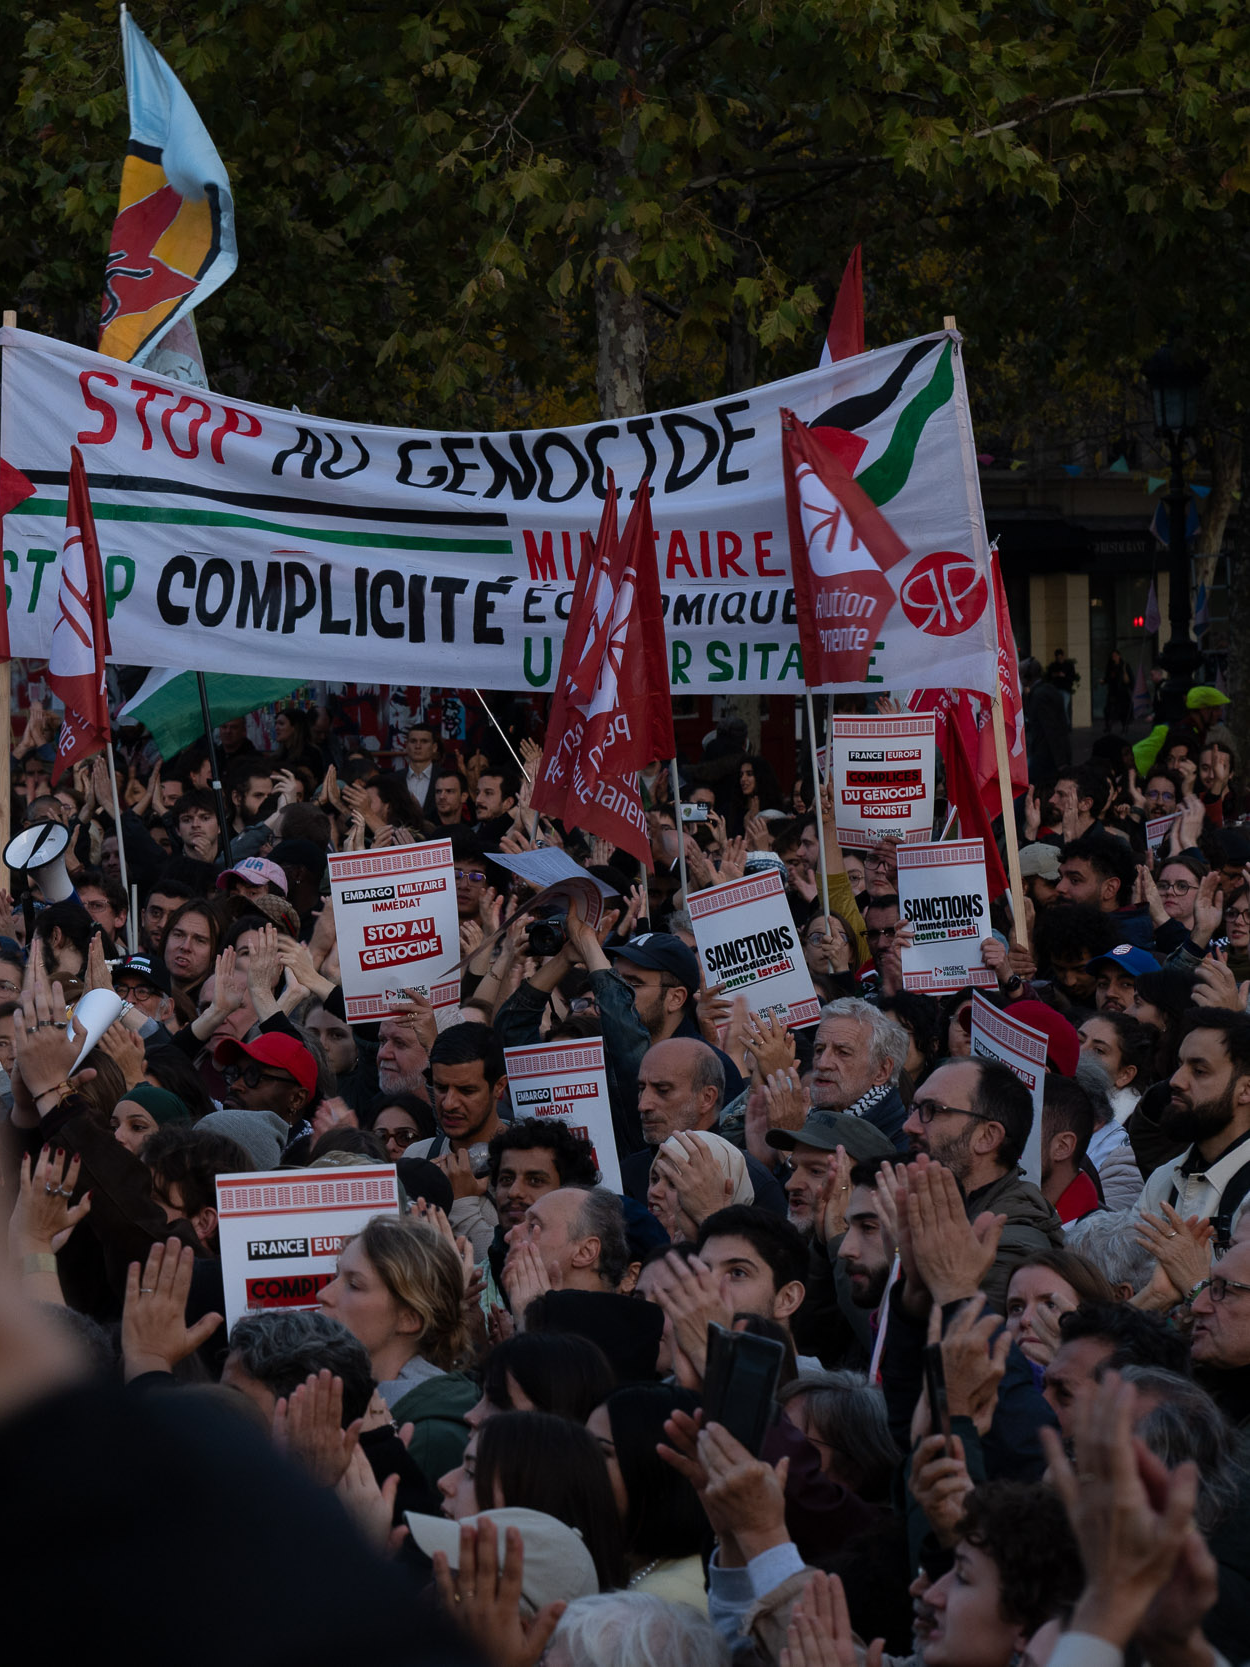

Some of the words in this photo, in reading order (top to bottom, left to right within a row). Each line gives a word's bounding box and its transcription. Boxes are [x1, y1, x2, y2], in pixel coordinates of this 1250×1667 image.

[77, 370, 262, 464] STOP
[271, 426, 370, 481] AU
[396, 400, 756, 503] GENOCIDE
[523, 530, 786, 581] MIAIRE
[2, 549, 136, 619] STP
[157, 555, 519, 645] COMPLICITÉ
[887, 750, 919, 759] EUROPE
[850, 771, 918, 783] COMPLICES
[844, 791, 860, 801] DU
[862, 785, 923, 801] GÉNOCIDE
[863, 805, 909, 815] SIONISTE
[344, 887, 393, 901] EMBARGO
[399, 880, 444, 894] MILITAIRE
[372, 898, 421, 912] IMMÉDIAT
[903, 894, 984, 921] SANCTIONS
[367, 923, 406, 941] STOP
[410, 920, 431, 936] AU
[915, 931, 946, 941] contre
[948, 926, 977, 937] Israël
[916, 919, 972, 931] immédiates
[362, 938, 439, 965] GÉNOCIDE
[705, 926, 794, 972] SANCTIONS
[720, 952, 784, 979] immédiates
[726, 972, 756, 988] ontre
[757, 960, 791, 978] Israël
[517, 1089, 550, 1102] EMBARGO
[554, 1084, 596, 1098] MILITAIRE
[535, 1102, 574, 1117] IMMÉDIAT
[250, 1240, 306, 1256] FRANCE
[314, 1237, 343, 1252] EUR
